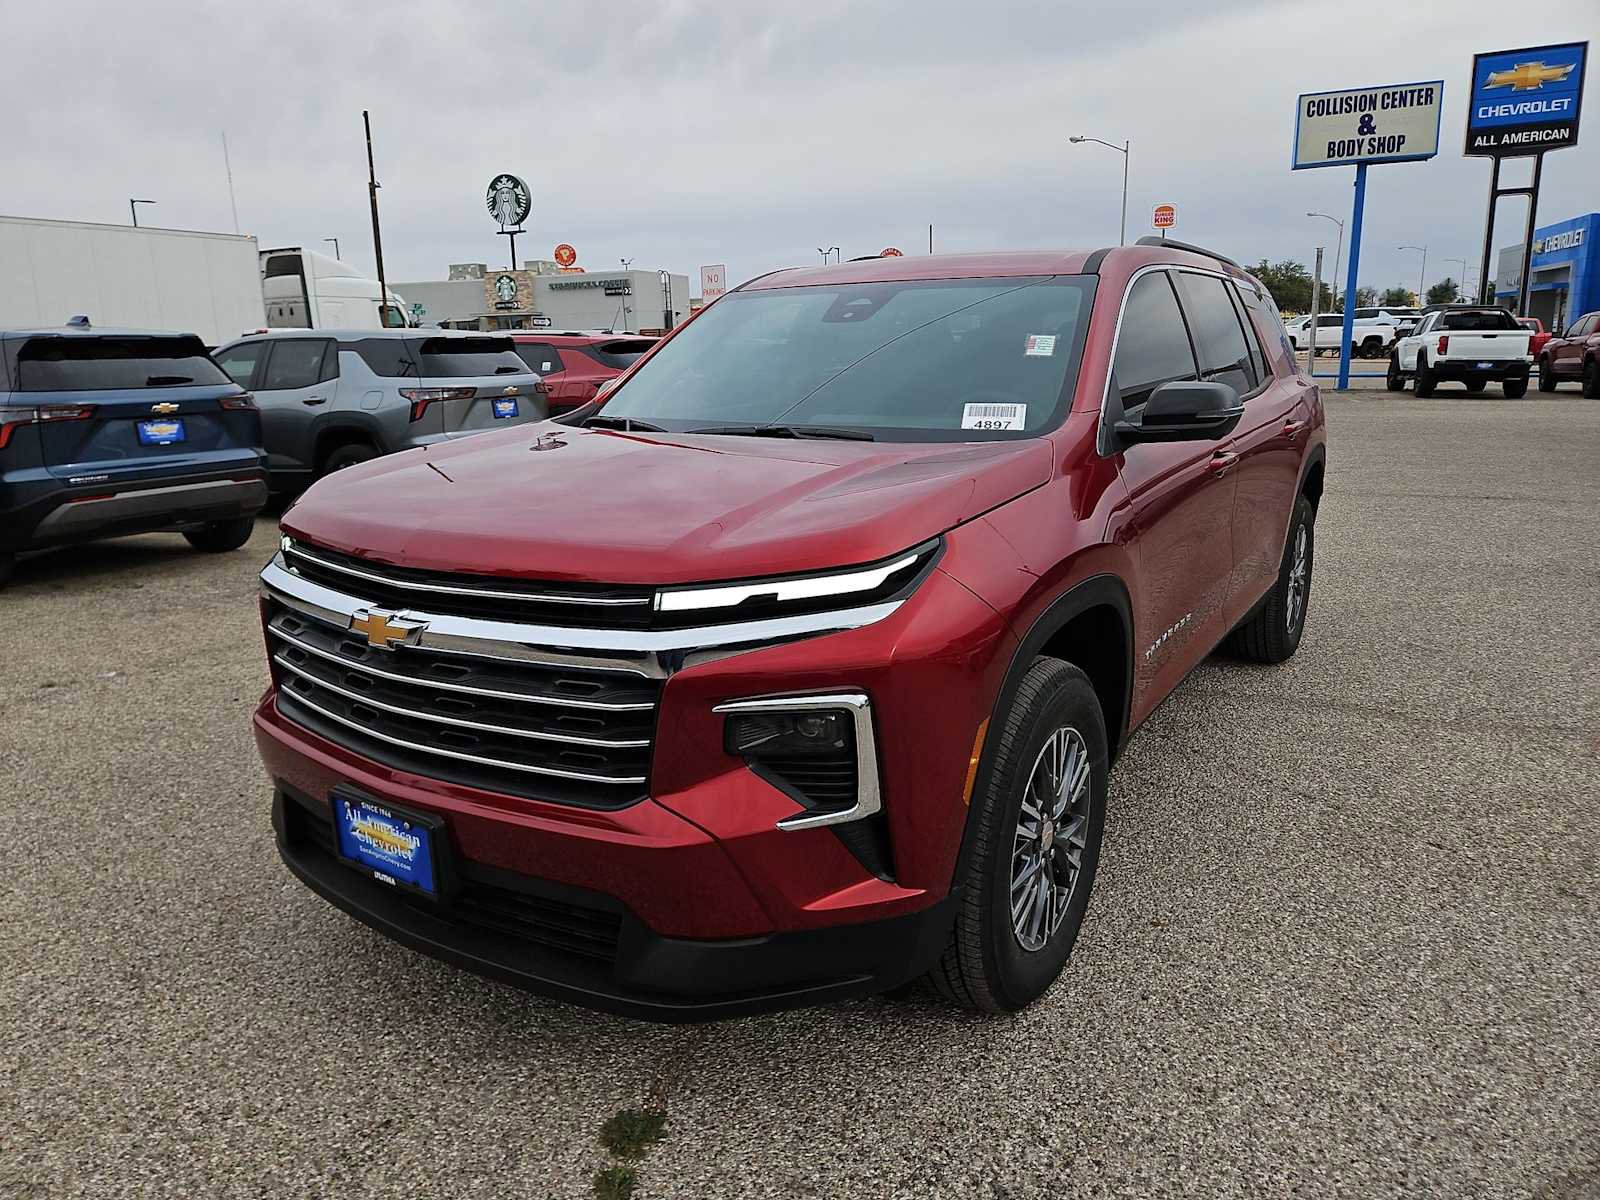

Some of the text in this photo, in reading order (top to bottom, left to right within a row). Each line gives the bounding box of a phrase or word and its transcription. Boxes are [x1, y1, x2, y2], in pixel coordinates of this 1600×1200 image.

[1306, 87, 1434, 118] COLLISION CENTER
[1478, 98, 1572, 119] CHEVROLET
[1357, 113, 1377, 136] &
[1327, 134, 1406, 159] BODY SHOP
[1474, 127, 1570, 147] ALL AMERICAN
[1154, 216, 1175, 224] KING
[1544, 228, 1586, 253] CHEVROLET
[707, 273, 719, 284] NO
[703, 287, 725, 296] PARKING
[973, 420, 1012, 430] 4897
[360, 801, 379, 814] SINCE
[345, 808, 421, 848] All American
[355, 829, 414, 862] Chevrolet
